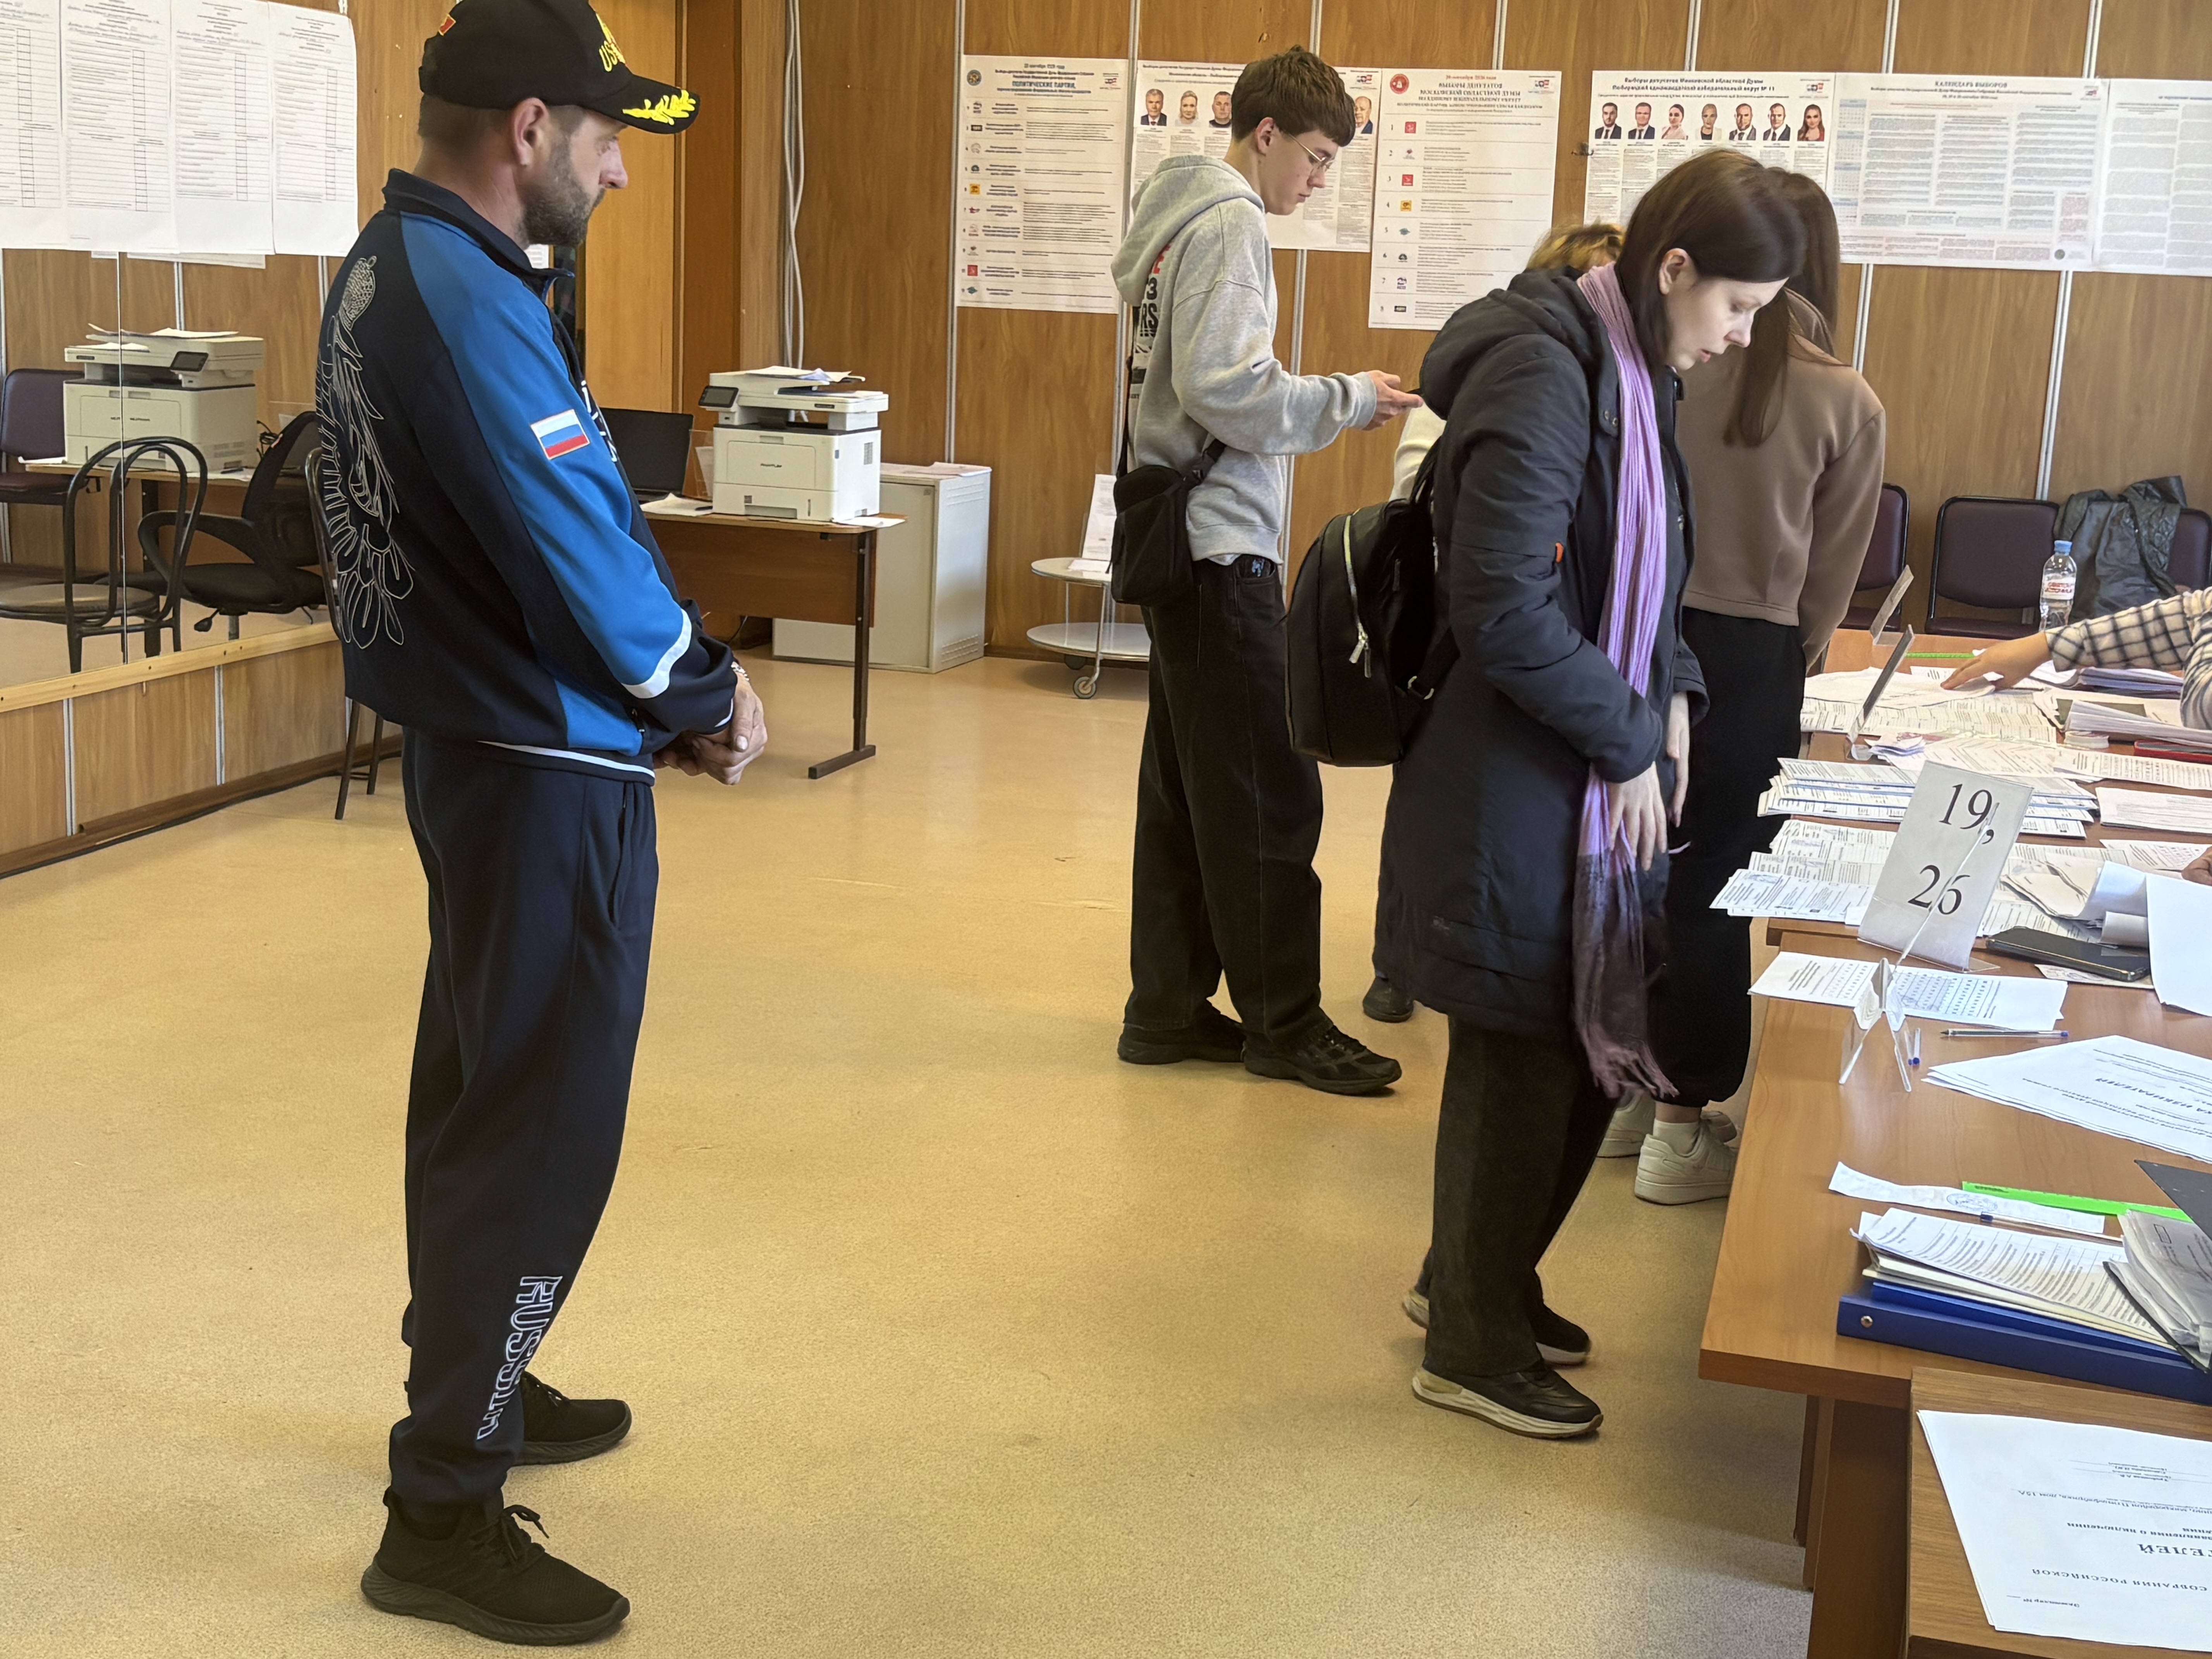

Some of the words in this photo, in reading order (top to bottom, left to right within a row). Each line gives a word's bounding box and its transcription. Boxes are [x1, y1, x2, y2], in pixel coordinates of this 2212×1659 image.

[1939, 783, 1995, 845] 19,
[1907, 865, 1971, 915] 26
[2032, 1568, 2127, 1585] РОССИЙСКОЙ
[2132, 1580, 2207, 1592] СОБРАНИЯ
